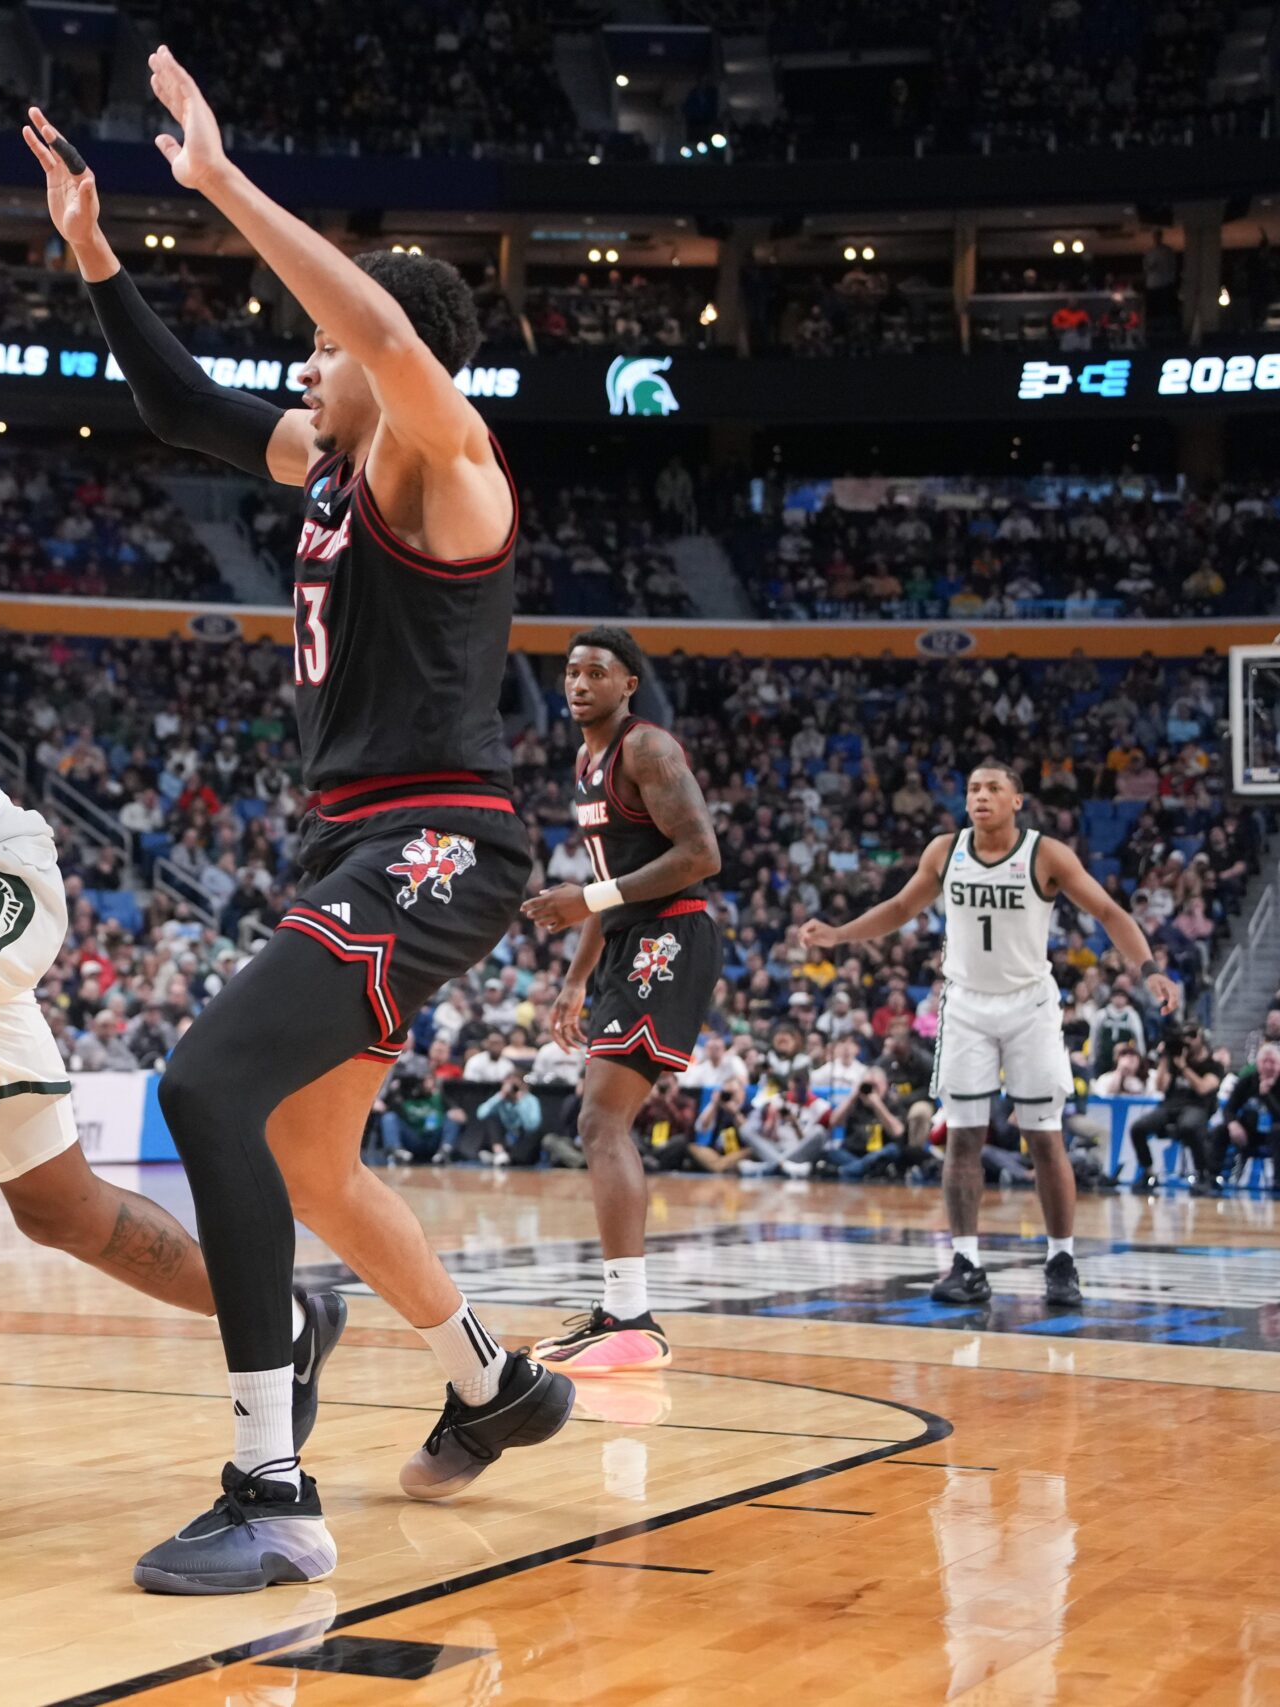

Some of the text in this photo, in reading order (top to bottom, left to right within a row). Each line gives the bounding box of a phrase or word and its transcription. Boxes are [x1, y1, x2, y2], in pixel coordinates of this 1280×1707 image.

[60, 350, 98, 378] VS
[1158, 354, 1280, 395] 2026
[950, 881, 1026, 910] STATE
[977, 915, 993, 952] 1
